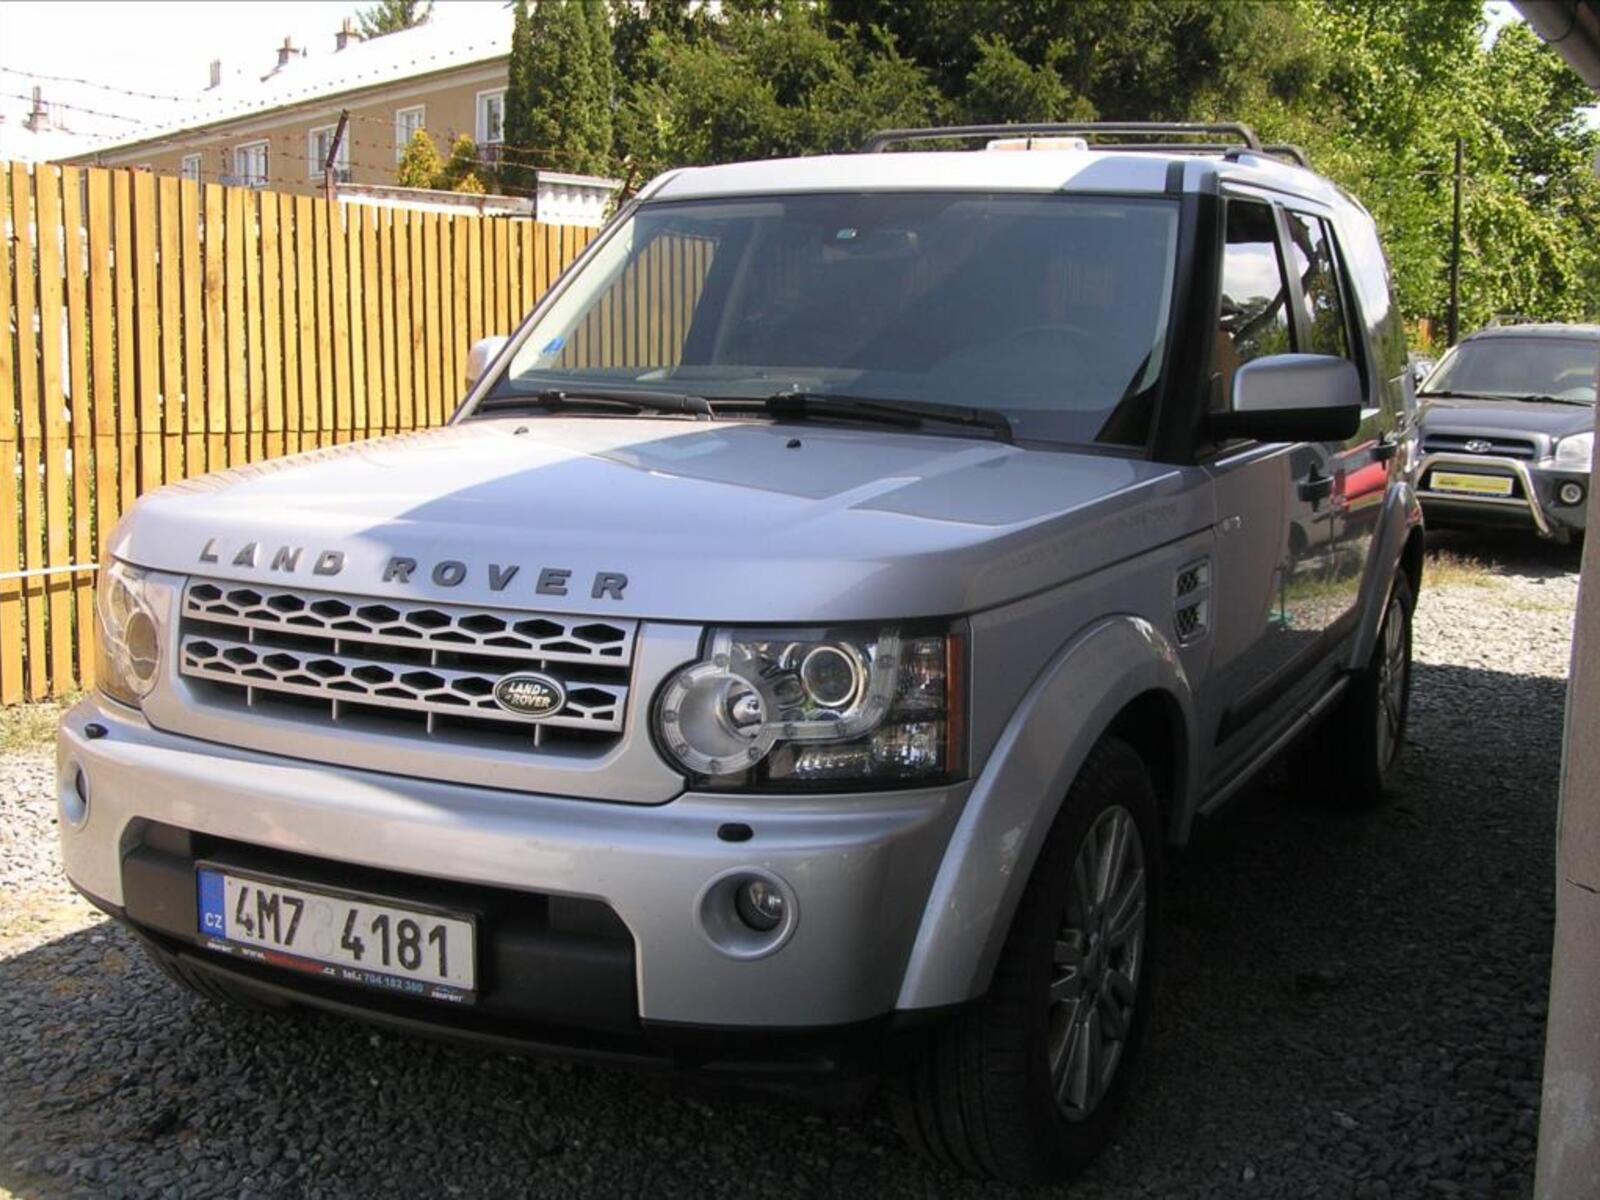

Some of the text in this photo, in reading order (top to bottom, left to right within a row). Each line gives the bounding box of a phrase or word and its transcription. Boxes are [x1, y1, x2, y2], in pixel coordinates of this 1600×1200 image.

[199, 538, 629, 601] LAND ROVER
[508, 682, 542, 695] LAND
[510, 693, 552, 708] ROVER
[204, 911, 223, 929] CZ
[235, 886, 305, 946] 4M7
[340, 908, 449, 978] 4181
